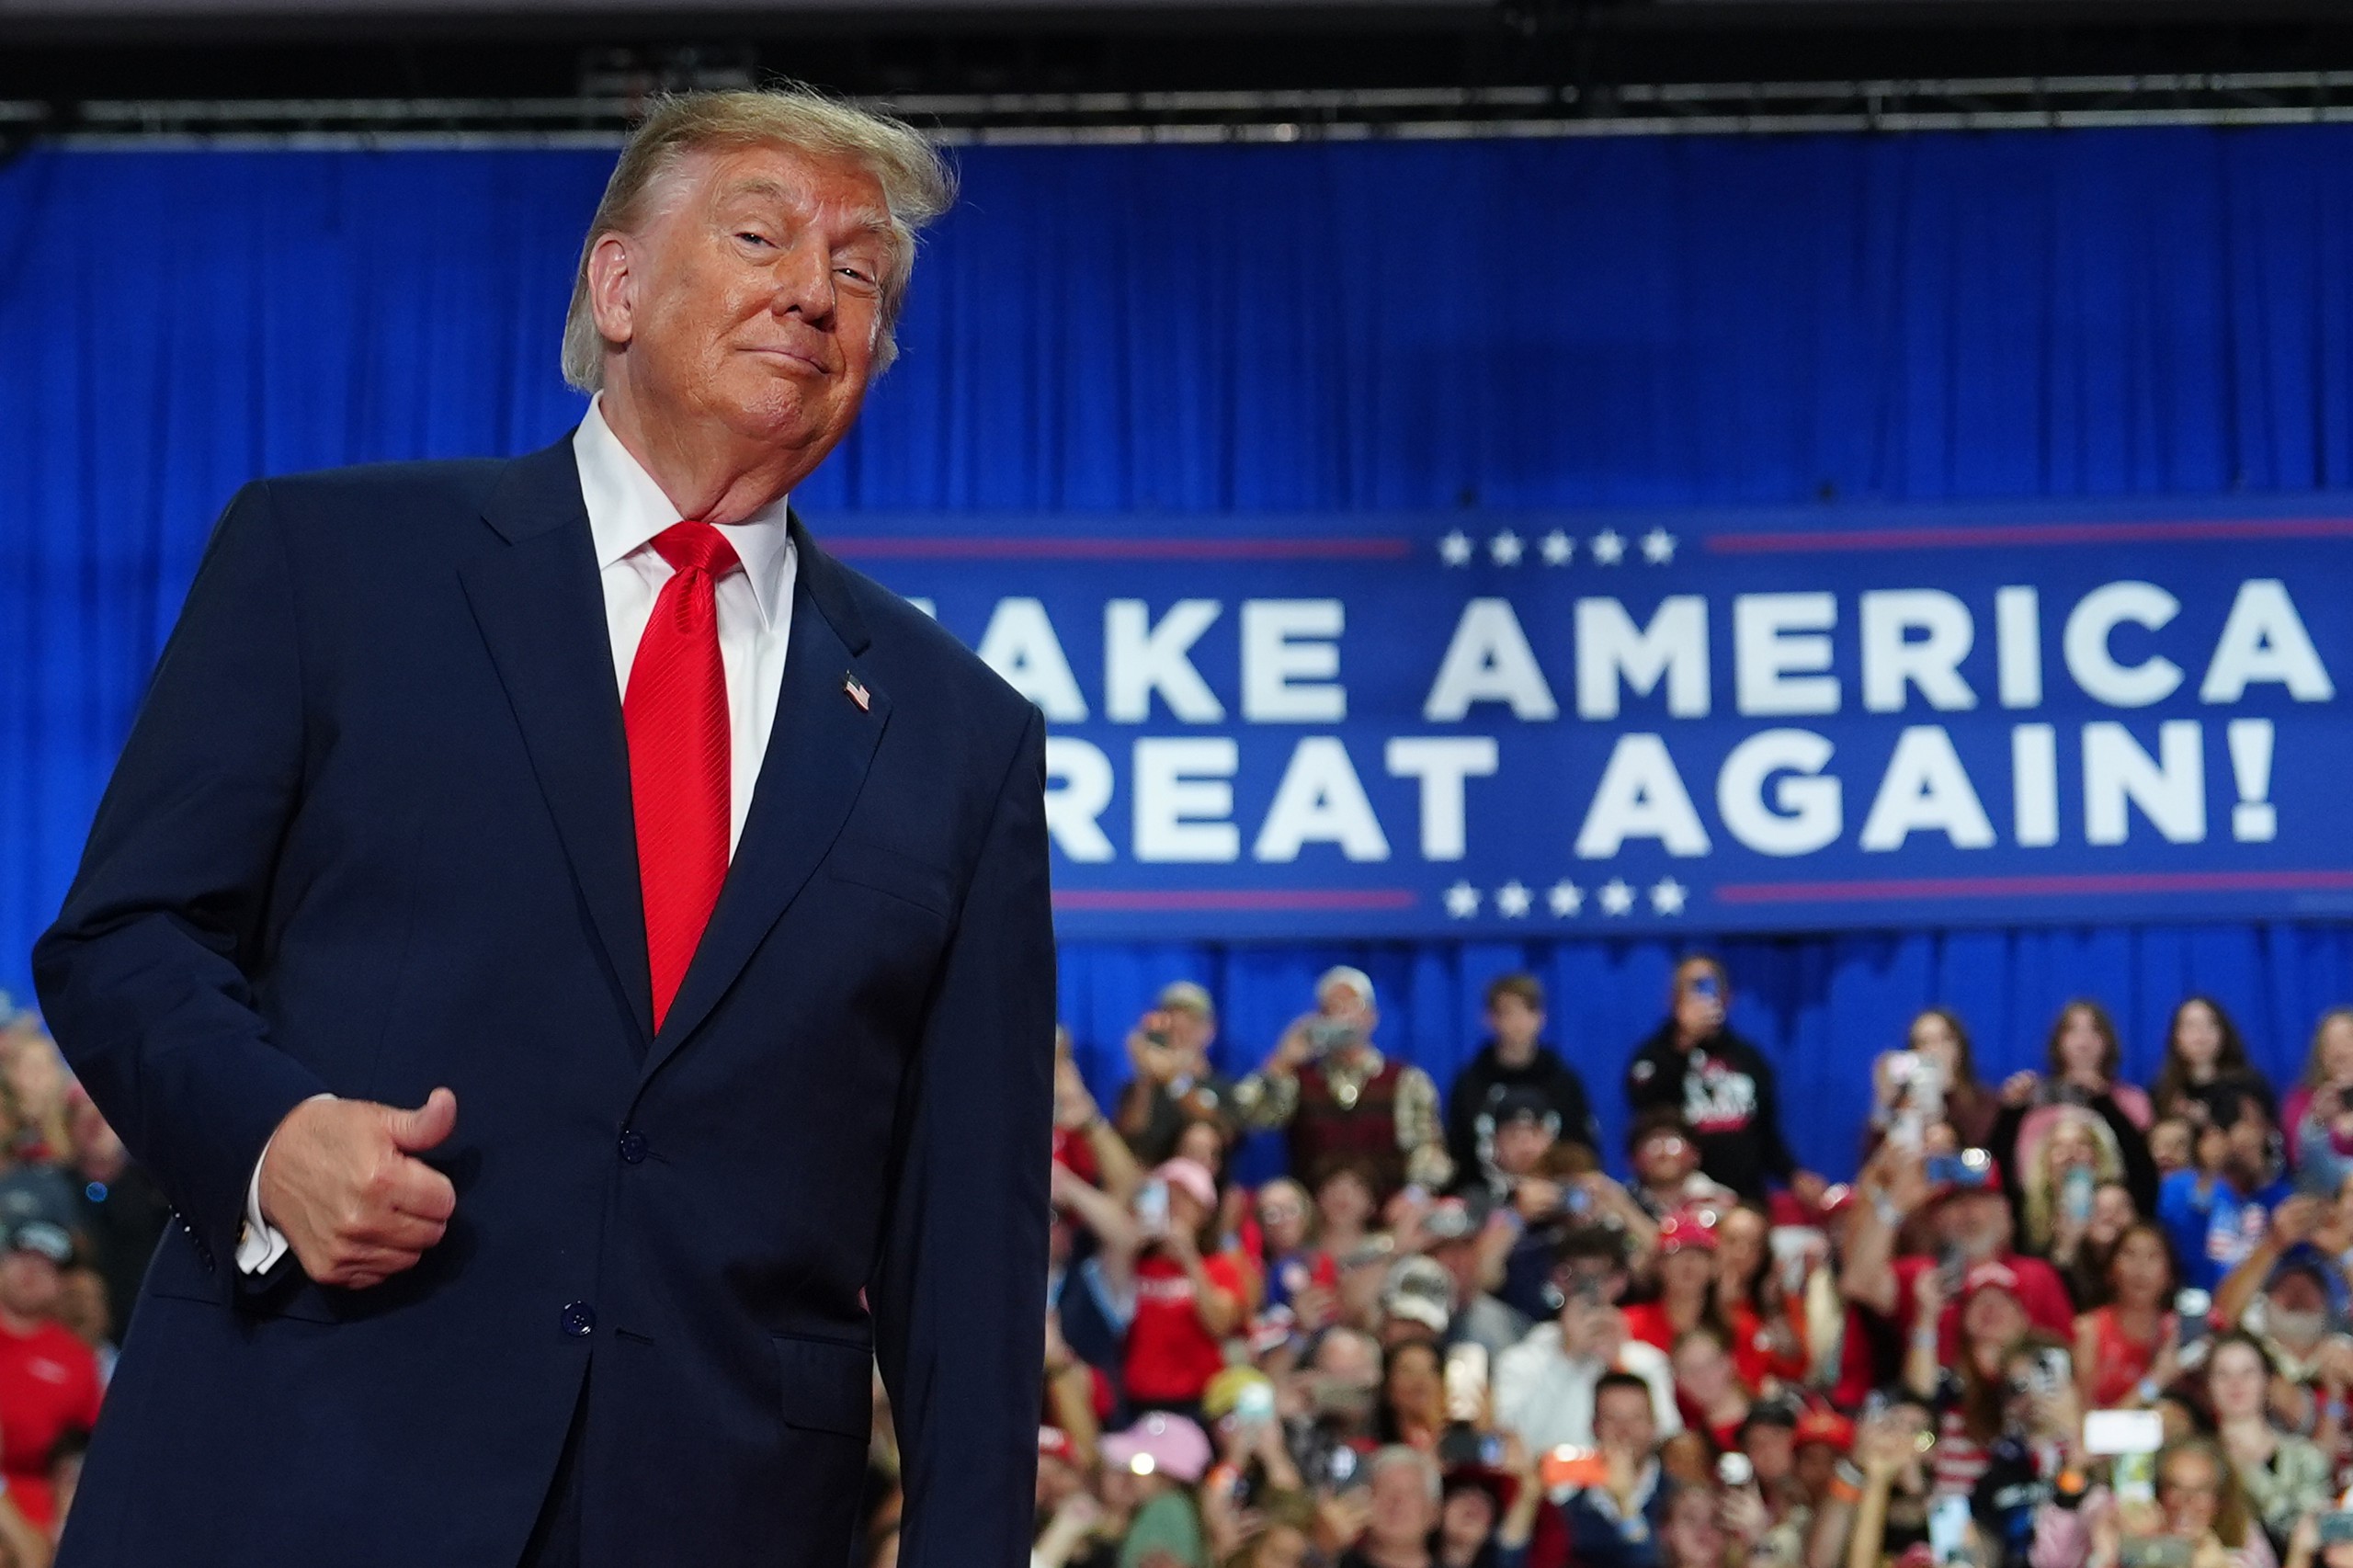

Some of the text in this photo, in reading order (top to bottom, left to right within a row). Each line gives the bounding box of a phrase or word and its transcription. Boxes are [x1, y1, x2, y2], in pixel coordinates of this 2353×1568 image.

[904, 579, 2335, 723] AKE AMERICA
[1044, 718, 2278, 863] REAT AGAIN!
